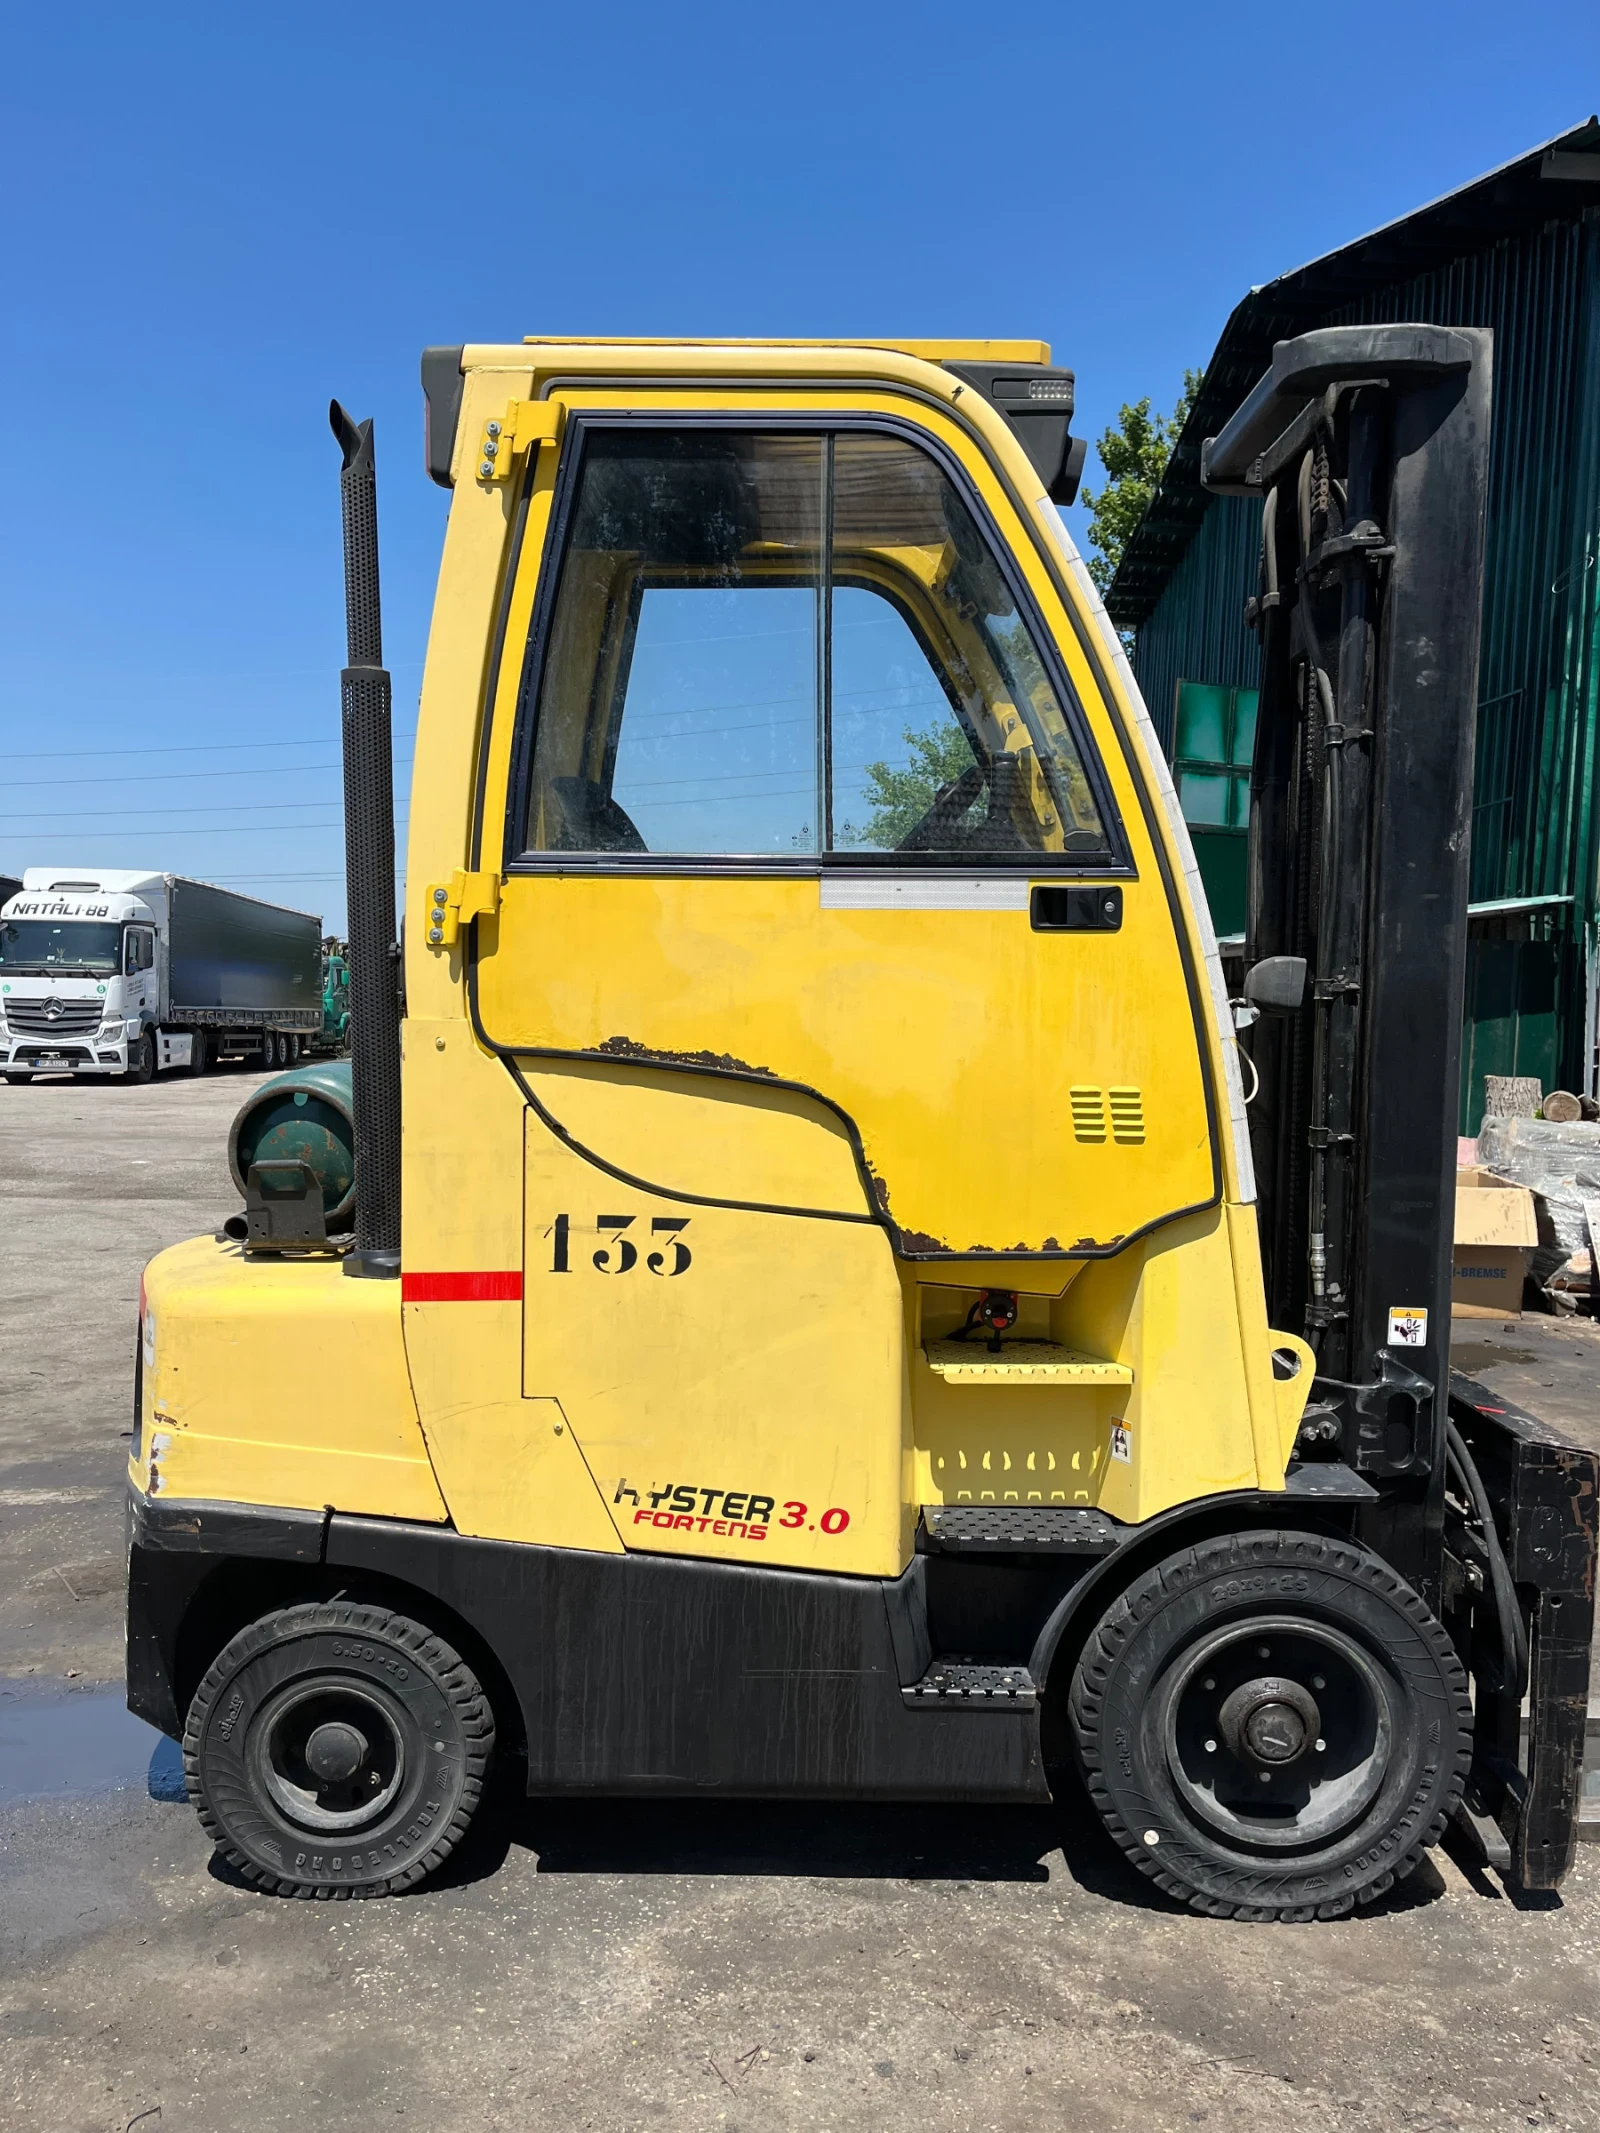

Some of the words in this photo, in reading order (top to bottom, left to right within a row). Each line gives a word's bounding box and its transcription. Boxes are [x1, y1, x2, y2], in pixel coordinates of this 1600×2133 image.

[12, 903, 109, 917] NATALI-88
[543, 1213, 692, 1276] 133
[633, 1509, 769, 1541] FORTENS
[779, 1501, 850, 1534] 3.0
[295, 1801, 441, 1870] TRELLEBORG
[1343, 1764, 1439, 1878] TRELLEBORG
